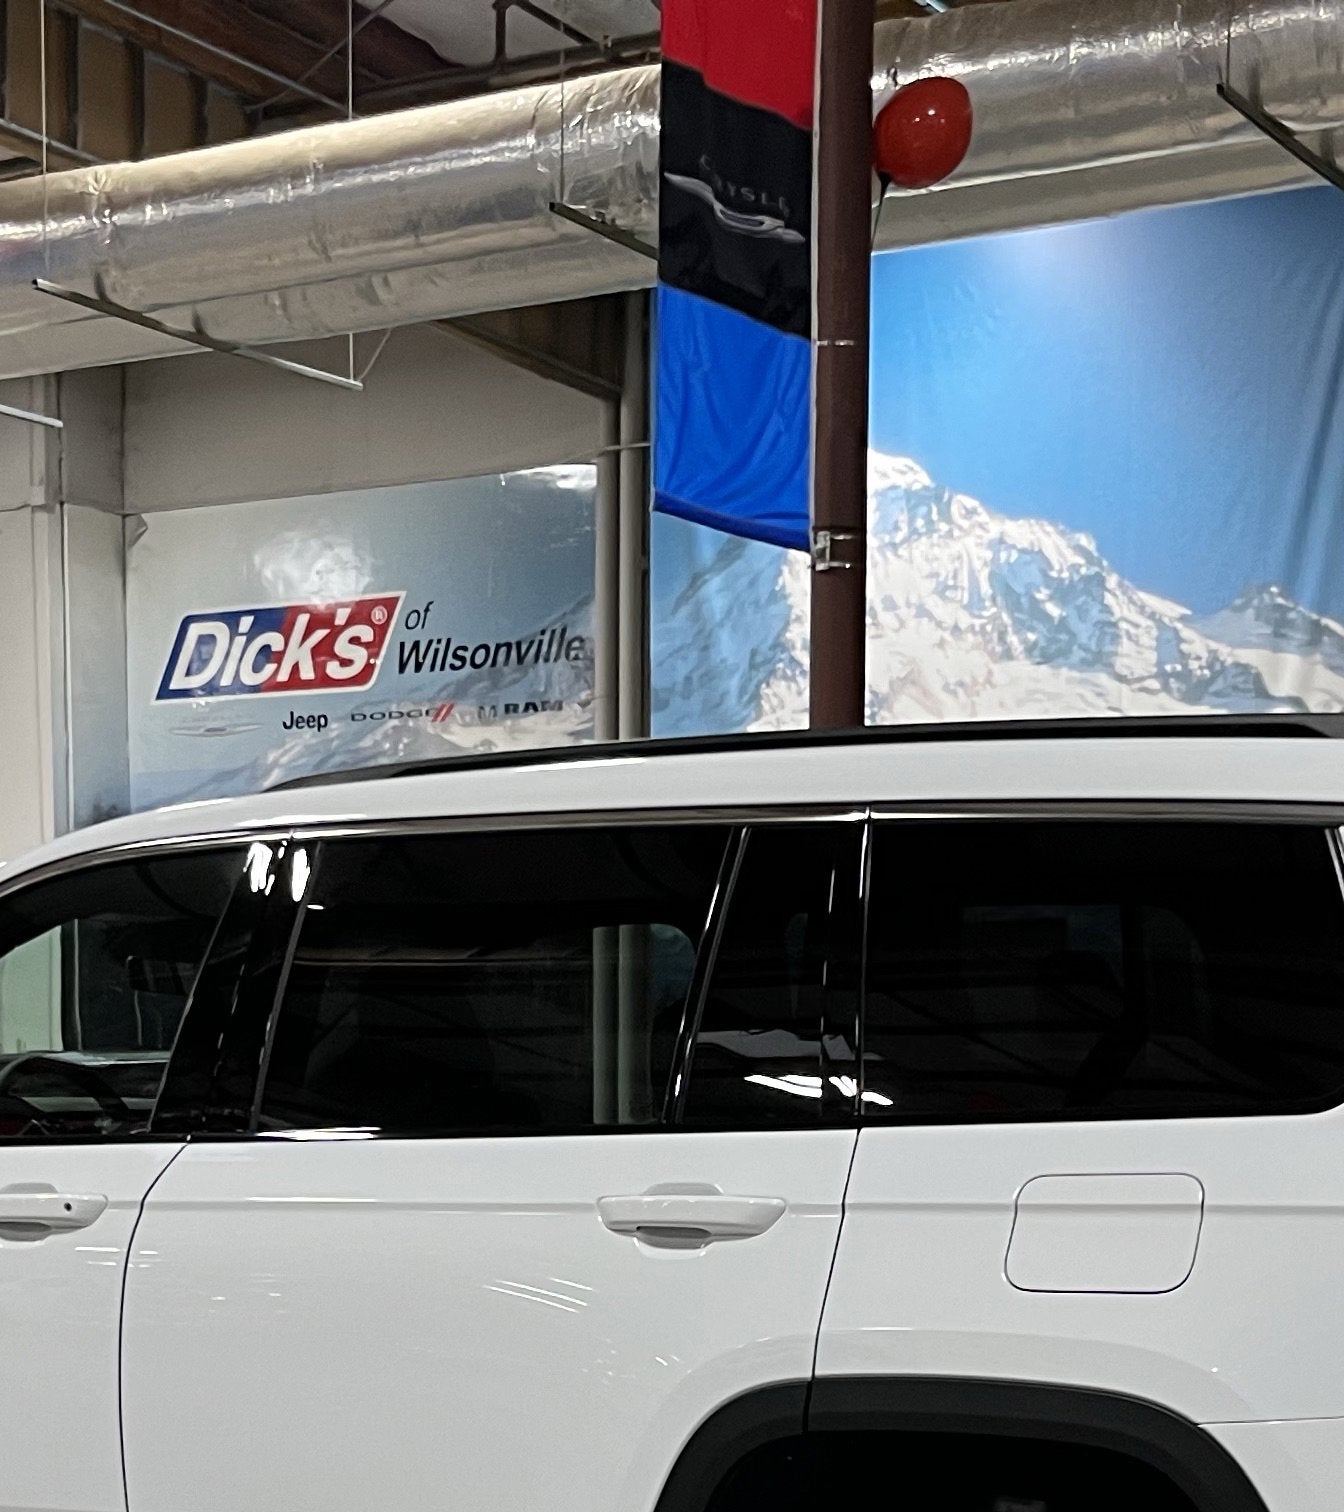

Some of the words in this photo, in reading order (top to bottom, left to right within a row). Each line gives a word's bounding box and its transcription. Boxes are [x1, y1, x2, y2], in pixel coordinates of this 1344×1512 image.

[169, 607, 374, 690] Dick's
[406, 601, 434, 630] of
[398, 624, 586, 675] Wilsonville
[283, 711, 328, 732] Jeep
